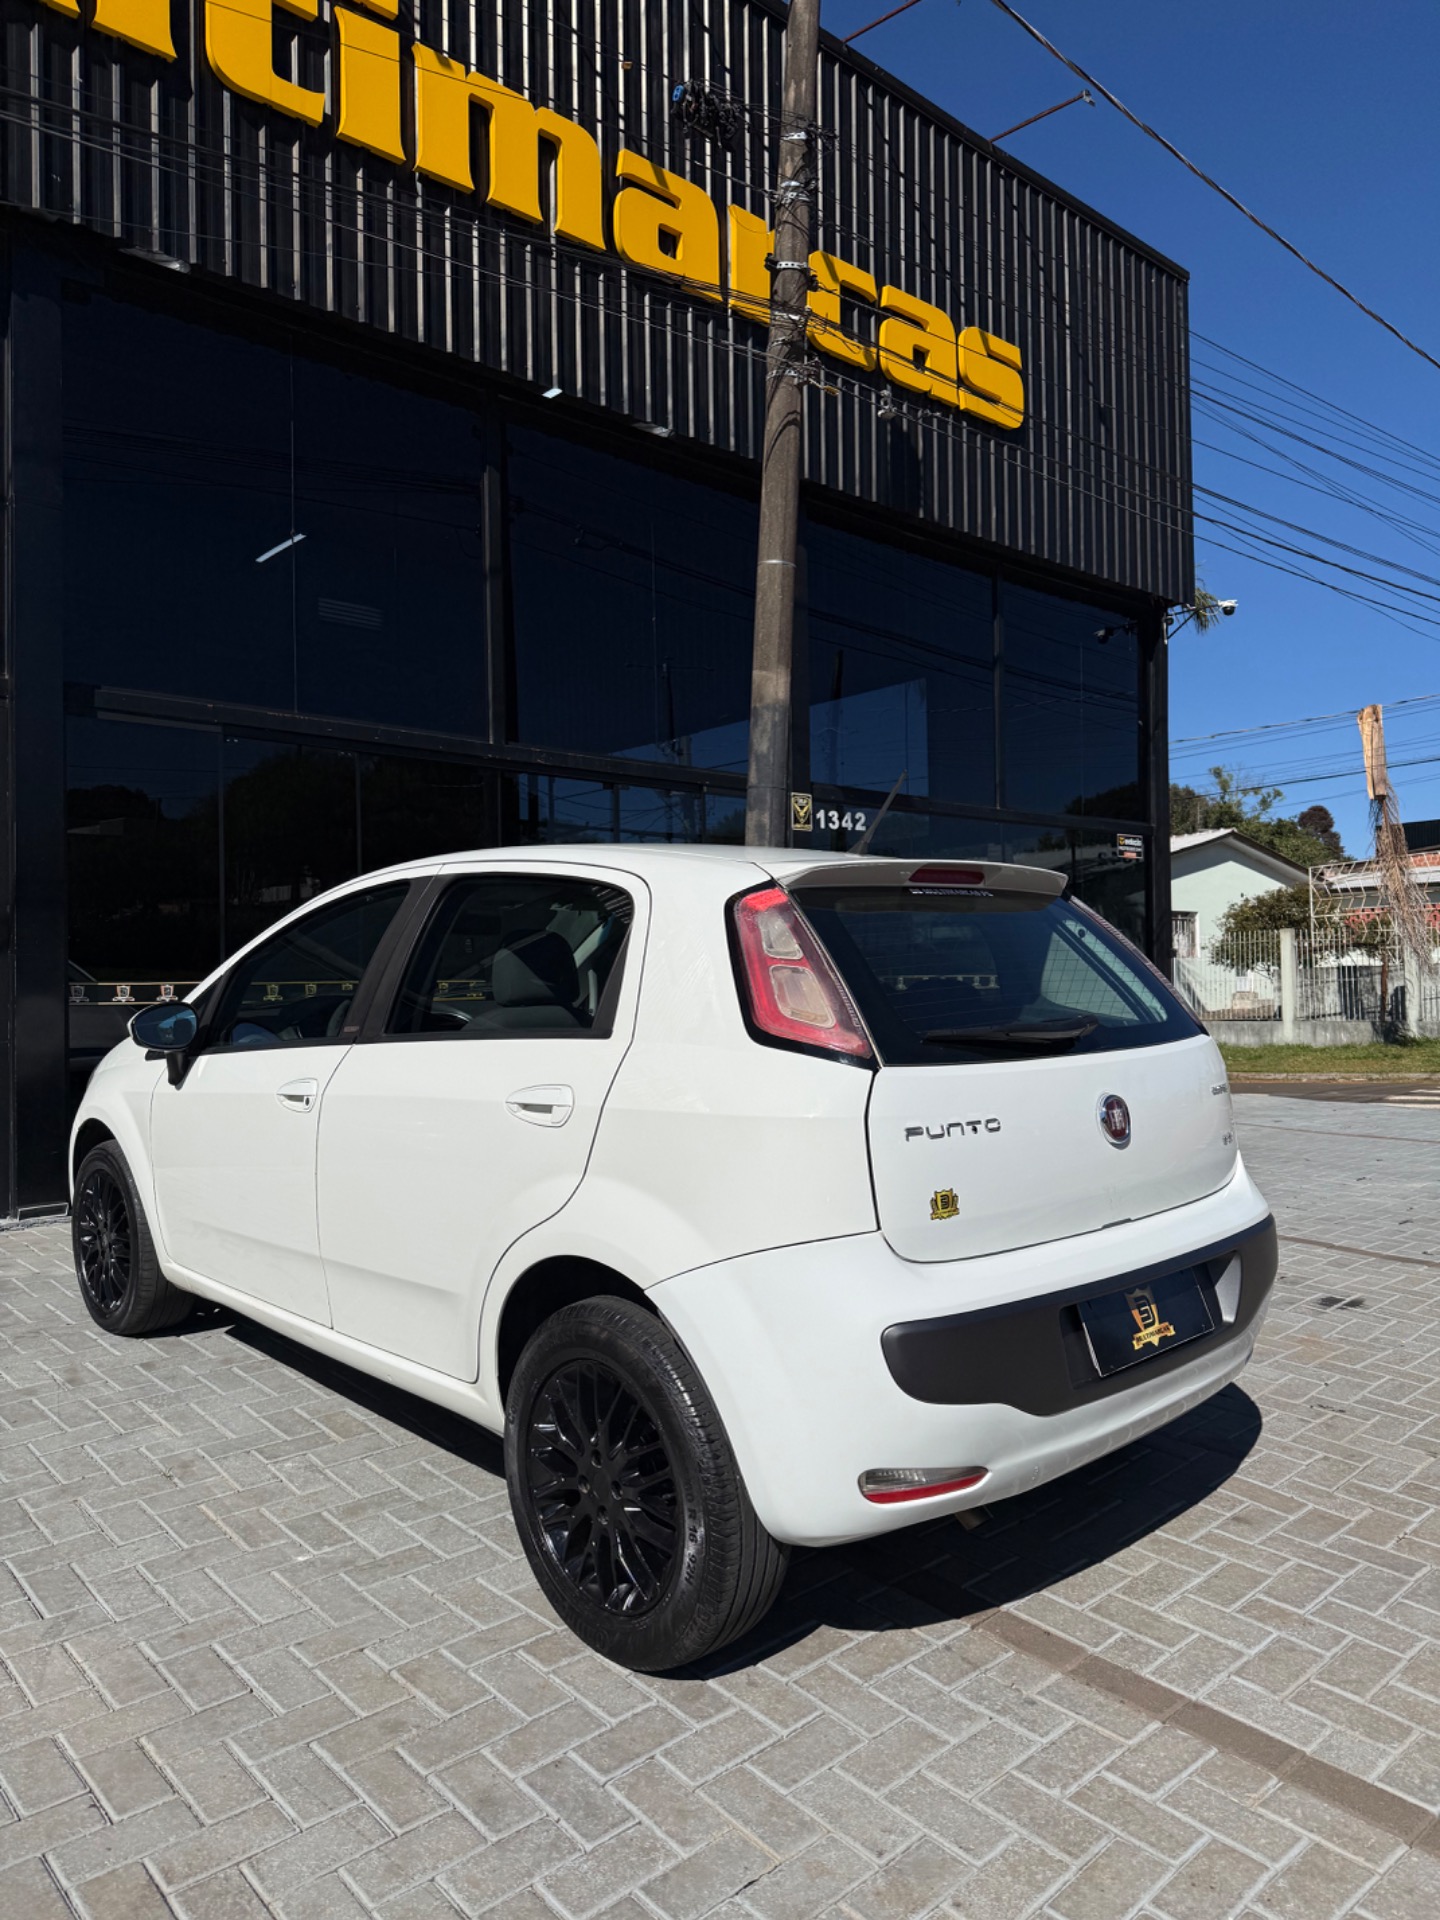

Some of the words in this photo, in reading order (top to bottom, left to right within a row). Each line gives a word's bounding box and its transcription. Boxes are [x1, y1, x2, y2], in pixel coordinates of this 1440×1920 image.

[816, 809, 867, 831] 1342
[905, 1118, 1001, 1142] PUNTO
[688, 1525, 699, 1544] 16
[684, 1554, 697, 1586] 92H
